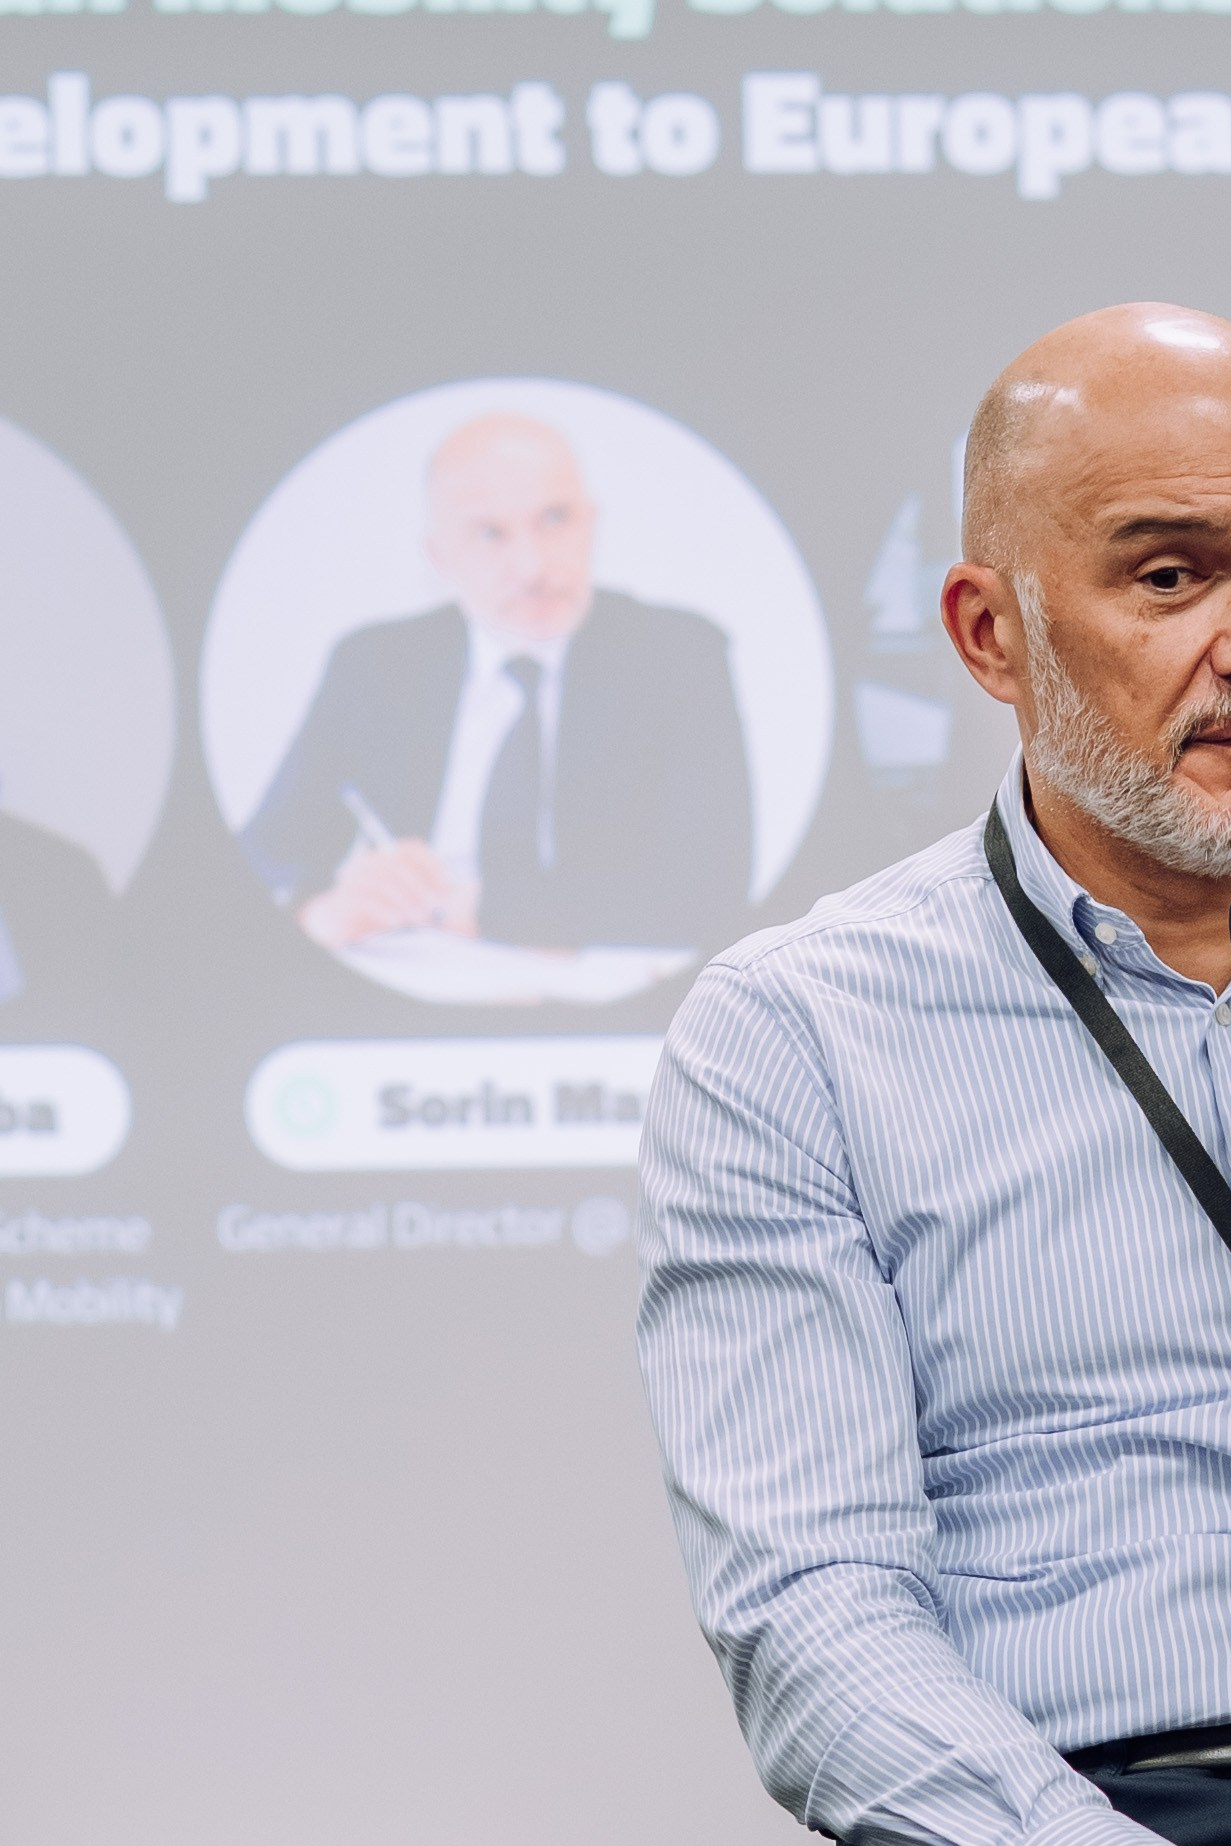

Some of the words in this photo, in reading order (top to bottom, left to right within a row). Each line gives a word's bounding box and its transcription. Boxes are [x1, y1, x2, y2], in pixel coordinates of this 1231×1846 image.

[0, 72, 565, 201] elopment
[587, 82, 719, 175] to
[377, 1080, 535, 1131] Sorin
[217, 1202, 386, 1252] General
[392, 1201, 564, 1250] Director
[6, 1279, 183, 1331] Mobility
